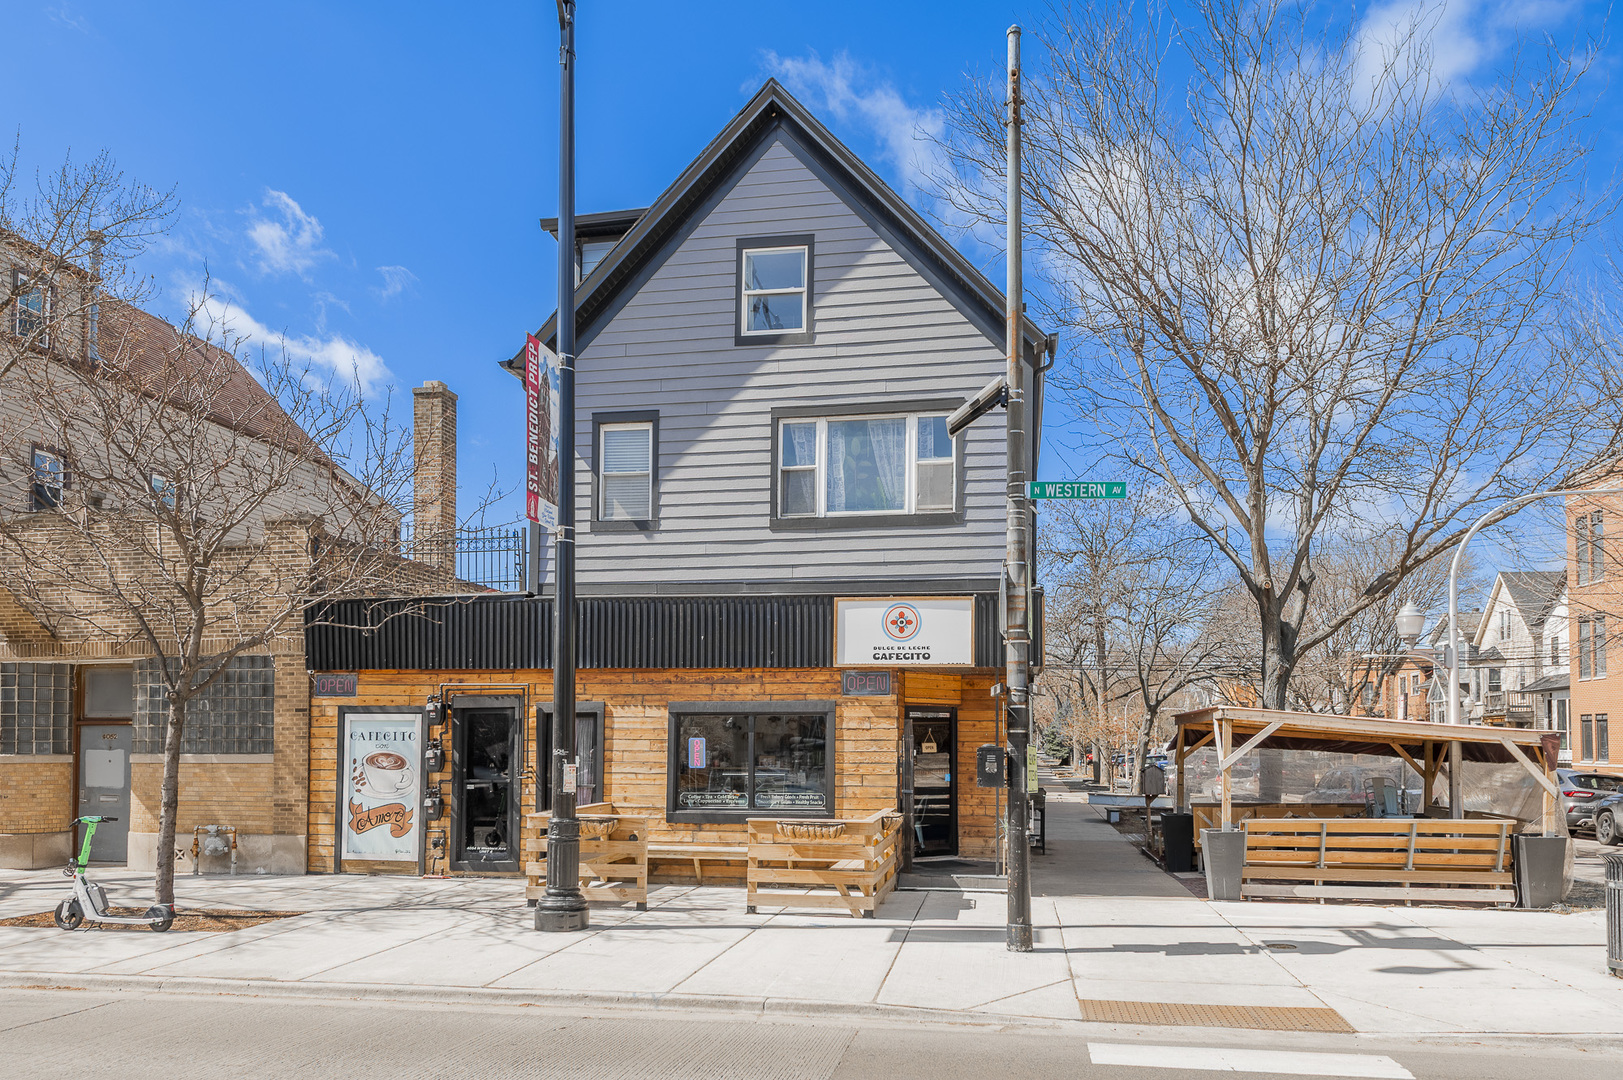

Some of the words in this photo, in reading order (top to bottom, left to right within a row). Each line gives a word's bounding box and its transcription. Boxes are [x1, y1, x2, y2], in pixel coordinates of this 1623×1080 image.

[528, 342, 538, 386] PREP
[528, 387, 540, 465] BENEDICT
[528, 470, 539, 493] ST.
[1034, 486, 1040, 495] N
[1045, 483, 1106, 497] WESTERN
[1112, 486, 1122, 494] AV
[872, 652, 931, 661] CAFECITO
[320, 678, 353, 693] OPEN
[847, 675, 887, 691] OPEN
[357, 806, 405, 831] Amor
